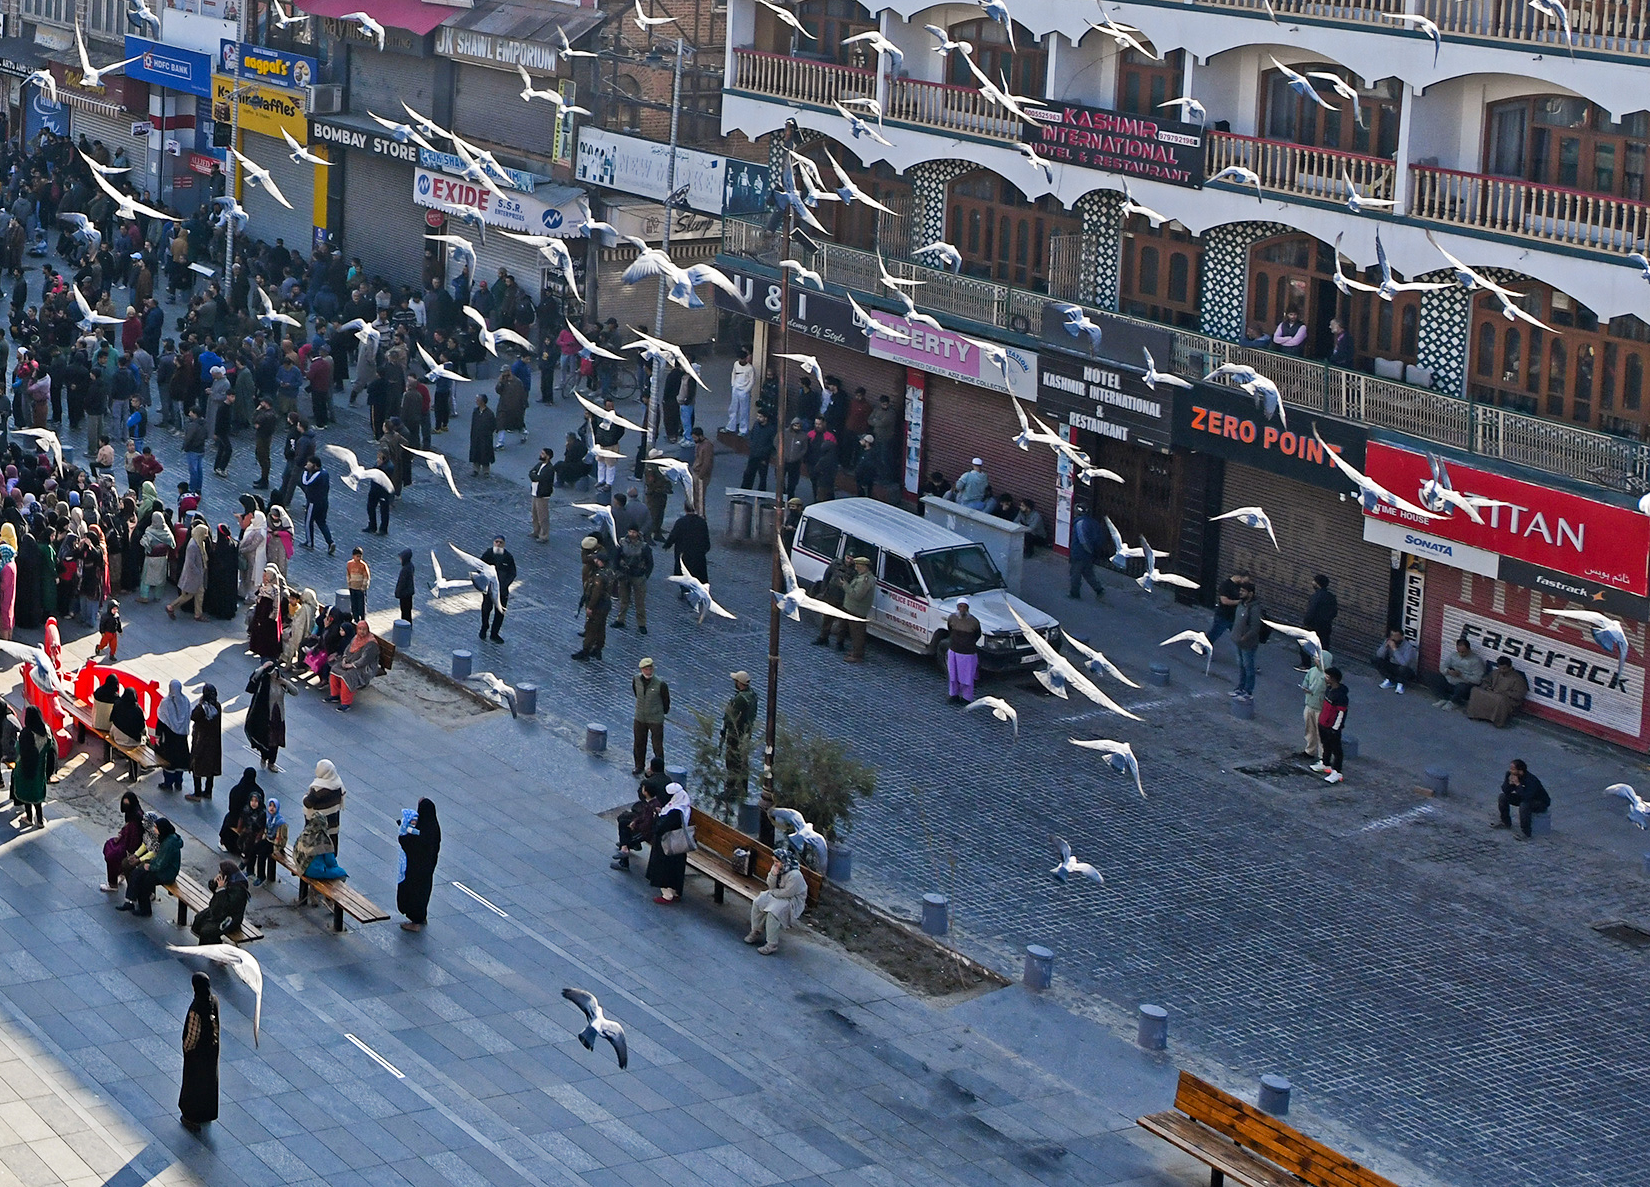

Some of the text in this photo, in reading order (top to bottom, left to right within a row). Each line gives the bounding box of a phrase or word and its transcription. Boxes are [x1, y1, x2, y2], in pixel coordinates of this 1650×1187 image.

[324, 17, 379, 47] Raymo
[436, 29, 556, 72] JK SHAWL EMPORIUM
[2, 58, 15, 70] ARTS
[15, 61, 27, 72] AND
[153, 58, 189, 75] HDFC BANK
[244, 56, 288, 76] nagpal's
[259, 96, 296, 118] affles
[1063, 107, 1158, 140] KASHMIR
[314, 123, 416, 162] BOMBAY STORE
[1041, 124, 1179, 165] INTERNATIONAL
[1159, 131, 1198, 146] 979792196
[1030, 141, 1192, 183] HOTEL & RESTAURANT
[432, 177, 491, 212] EXIDE
[497, 199, 523, 214] S.S.R.
[494, 208, 525, 222] ENTERPRISES
[733, 274, 807, 321] U & I
[771, 313, 847, 344] Ademy Of Style
[1005, 349, 1031, 373] TATION
[892, 355, 926, 370] AUTHORISED
[948, 370, 961, 380] AZIZ
[960, 374, 975, 384] SHOE
[976, 378, 1010, 393] COLLECTION
[1083, 366, 1122, 390] HOTEL
[1042, 371, 1162, 419] KASHMIR INTERNATIONAL
[1095, 404, 1104, 418] &
[1069, 411, 1129, 442] RESTAURANT
[1191, 406, 1344, 469] ZERO POINT
[1376, 504, 1430, 526] TIME HOUSE
[1404, 533, 1453, 557] SONATA
[1536, 574, 1589, 597] fastrack
[889, 591, 907, 605] POLICE
[907, 599, 927, 613] STATION
